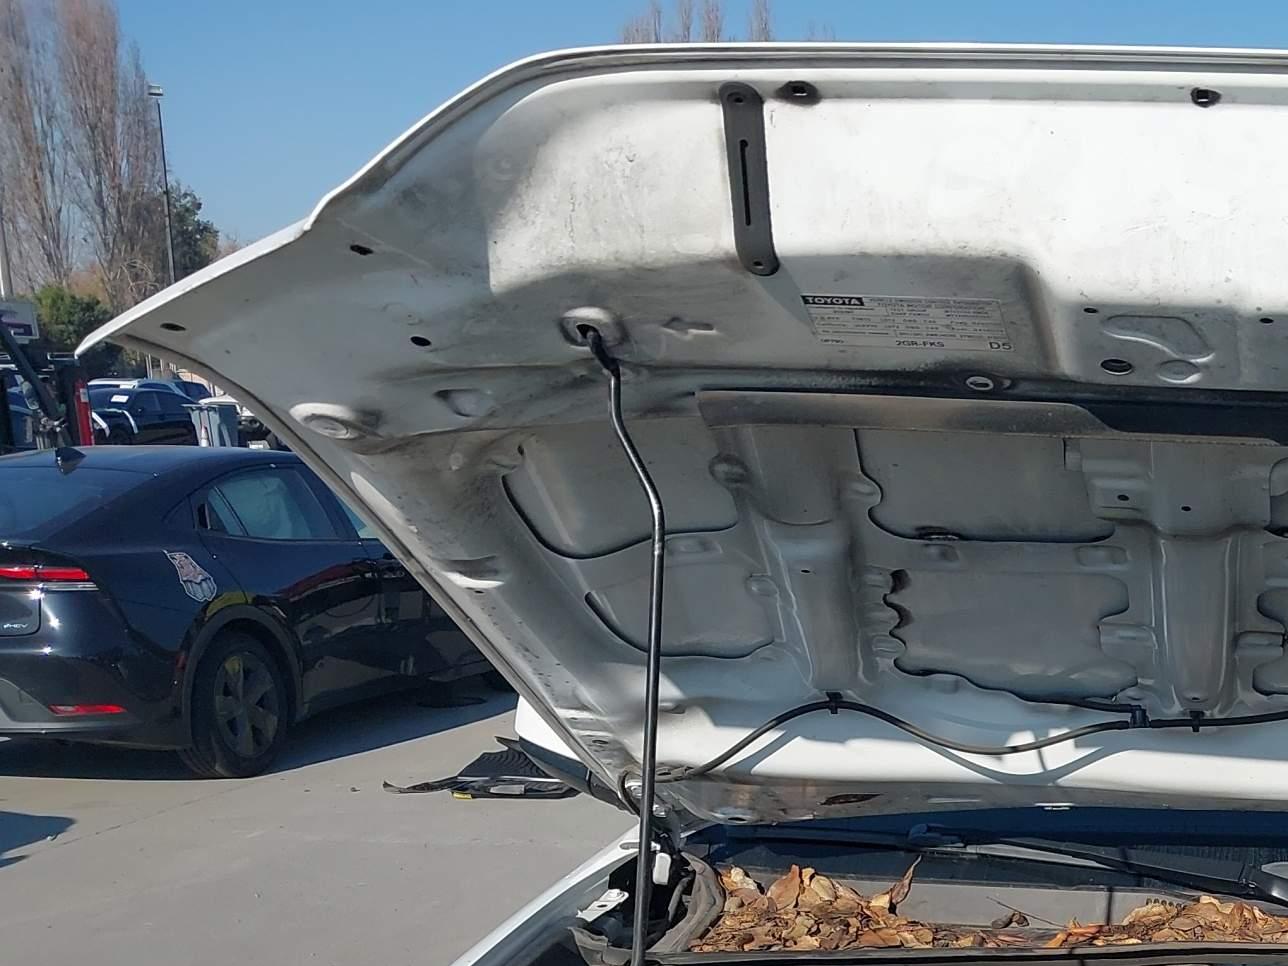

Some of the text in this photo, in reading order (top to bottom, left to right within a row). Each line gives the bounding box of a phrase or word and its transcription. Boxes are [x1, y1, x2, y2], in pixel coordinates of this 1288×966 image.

[805, 296, 862, 306] TOYOTA
[895, 339, 1013, 350] 2GR-FKS D5
